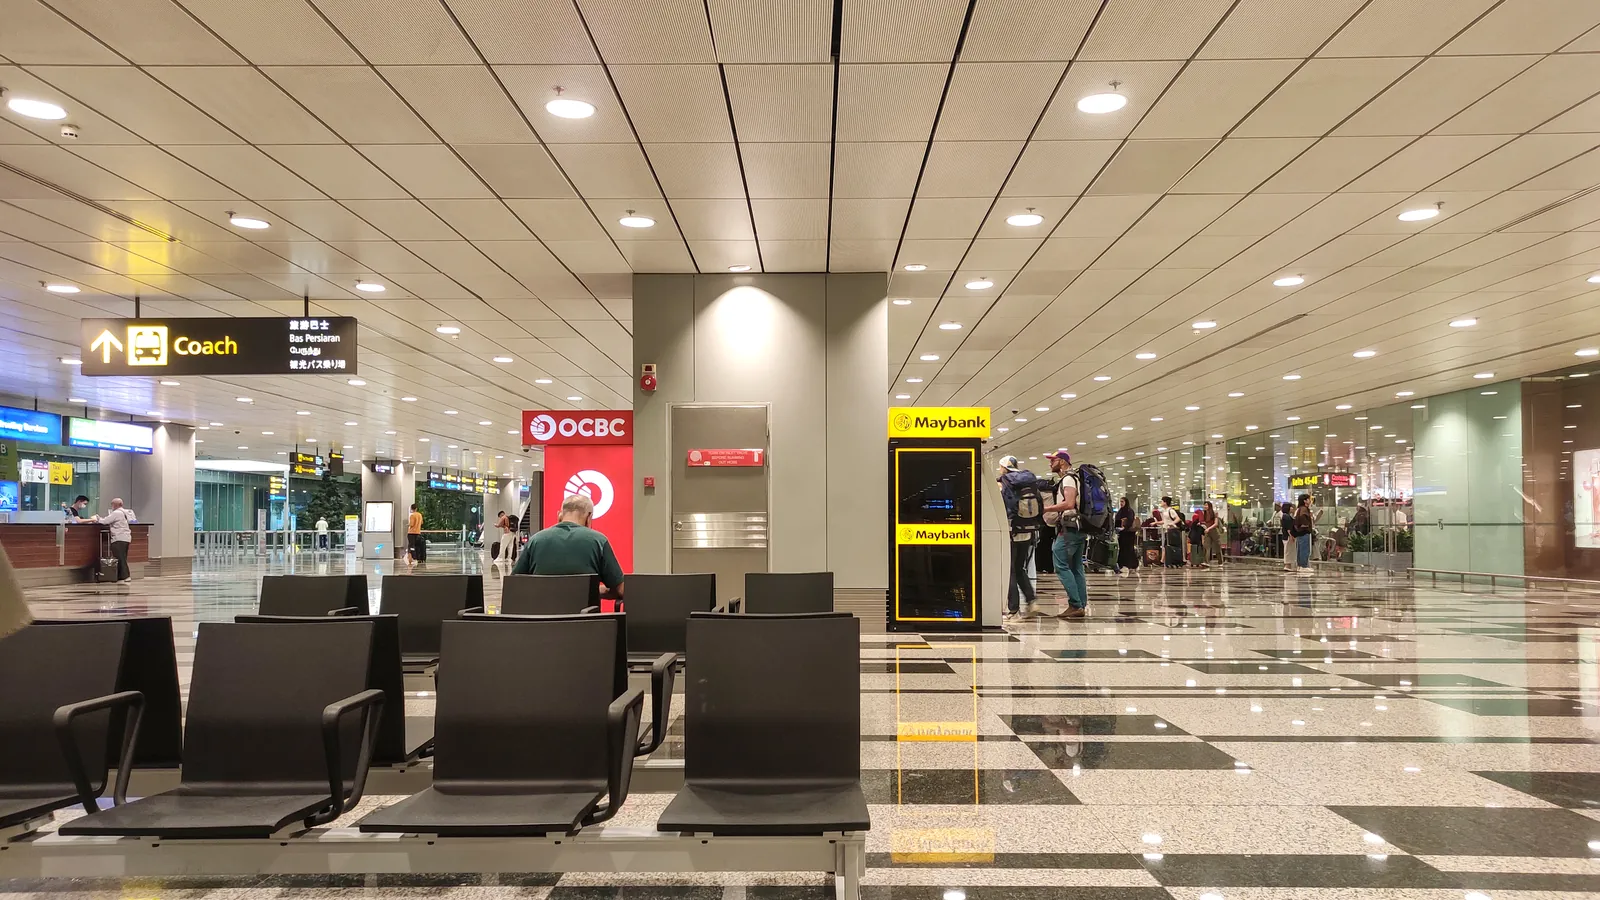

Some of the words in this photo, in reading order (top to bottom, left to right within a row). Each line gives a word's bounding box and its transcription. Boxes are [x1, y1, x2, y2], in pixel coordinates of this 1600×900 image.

[174, 335, 238, 355] Coach
[289, 333, 304, 343] Bas
[305, 333, 341, 343] Persiaran
[559, 418, 625, 437] OCBC
[914, 416, 986, 431] Maybank
[915, 530, 970, 541] Maybank
